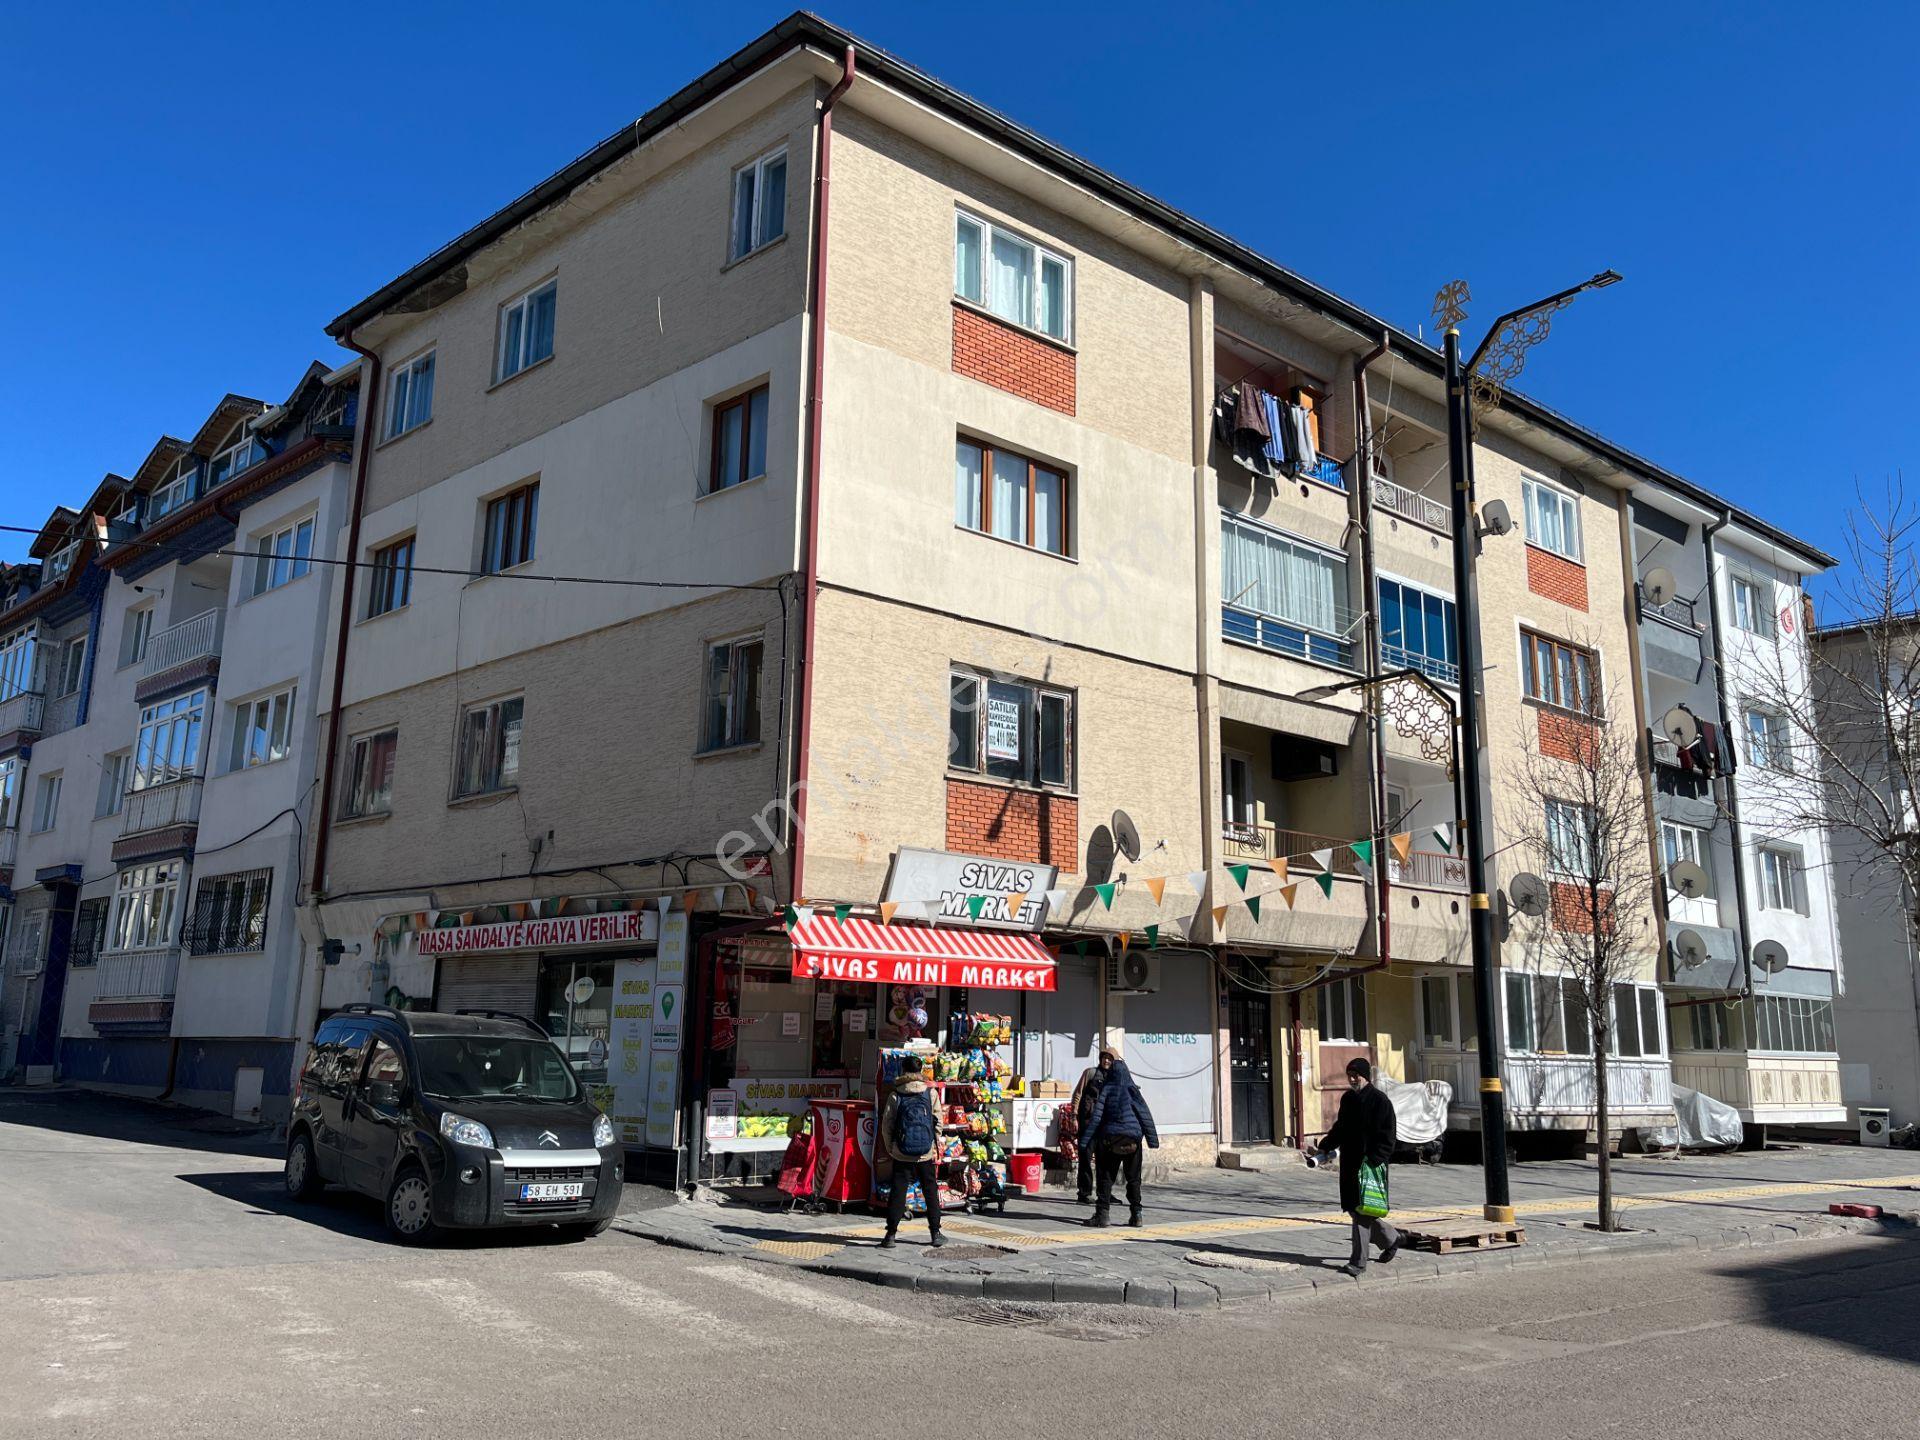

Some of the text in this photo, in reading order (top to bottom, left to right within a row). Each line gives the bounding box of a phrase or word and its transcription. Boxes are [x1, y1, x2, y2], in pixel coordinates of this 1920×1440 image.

[989, 700, 1017, 715] SATILIK
[989, 721, 1017, 731] EMLAK
[419, 930, 453, 952] MASA
[455, 924, 522, 950] SANDALYE
[961, 965, 1048, 988] MARKET
[788, 1083, 842, 1099] MARKET
[528, 1184, 580, 1197] 58 EH 591
